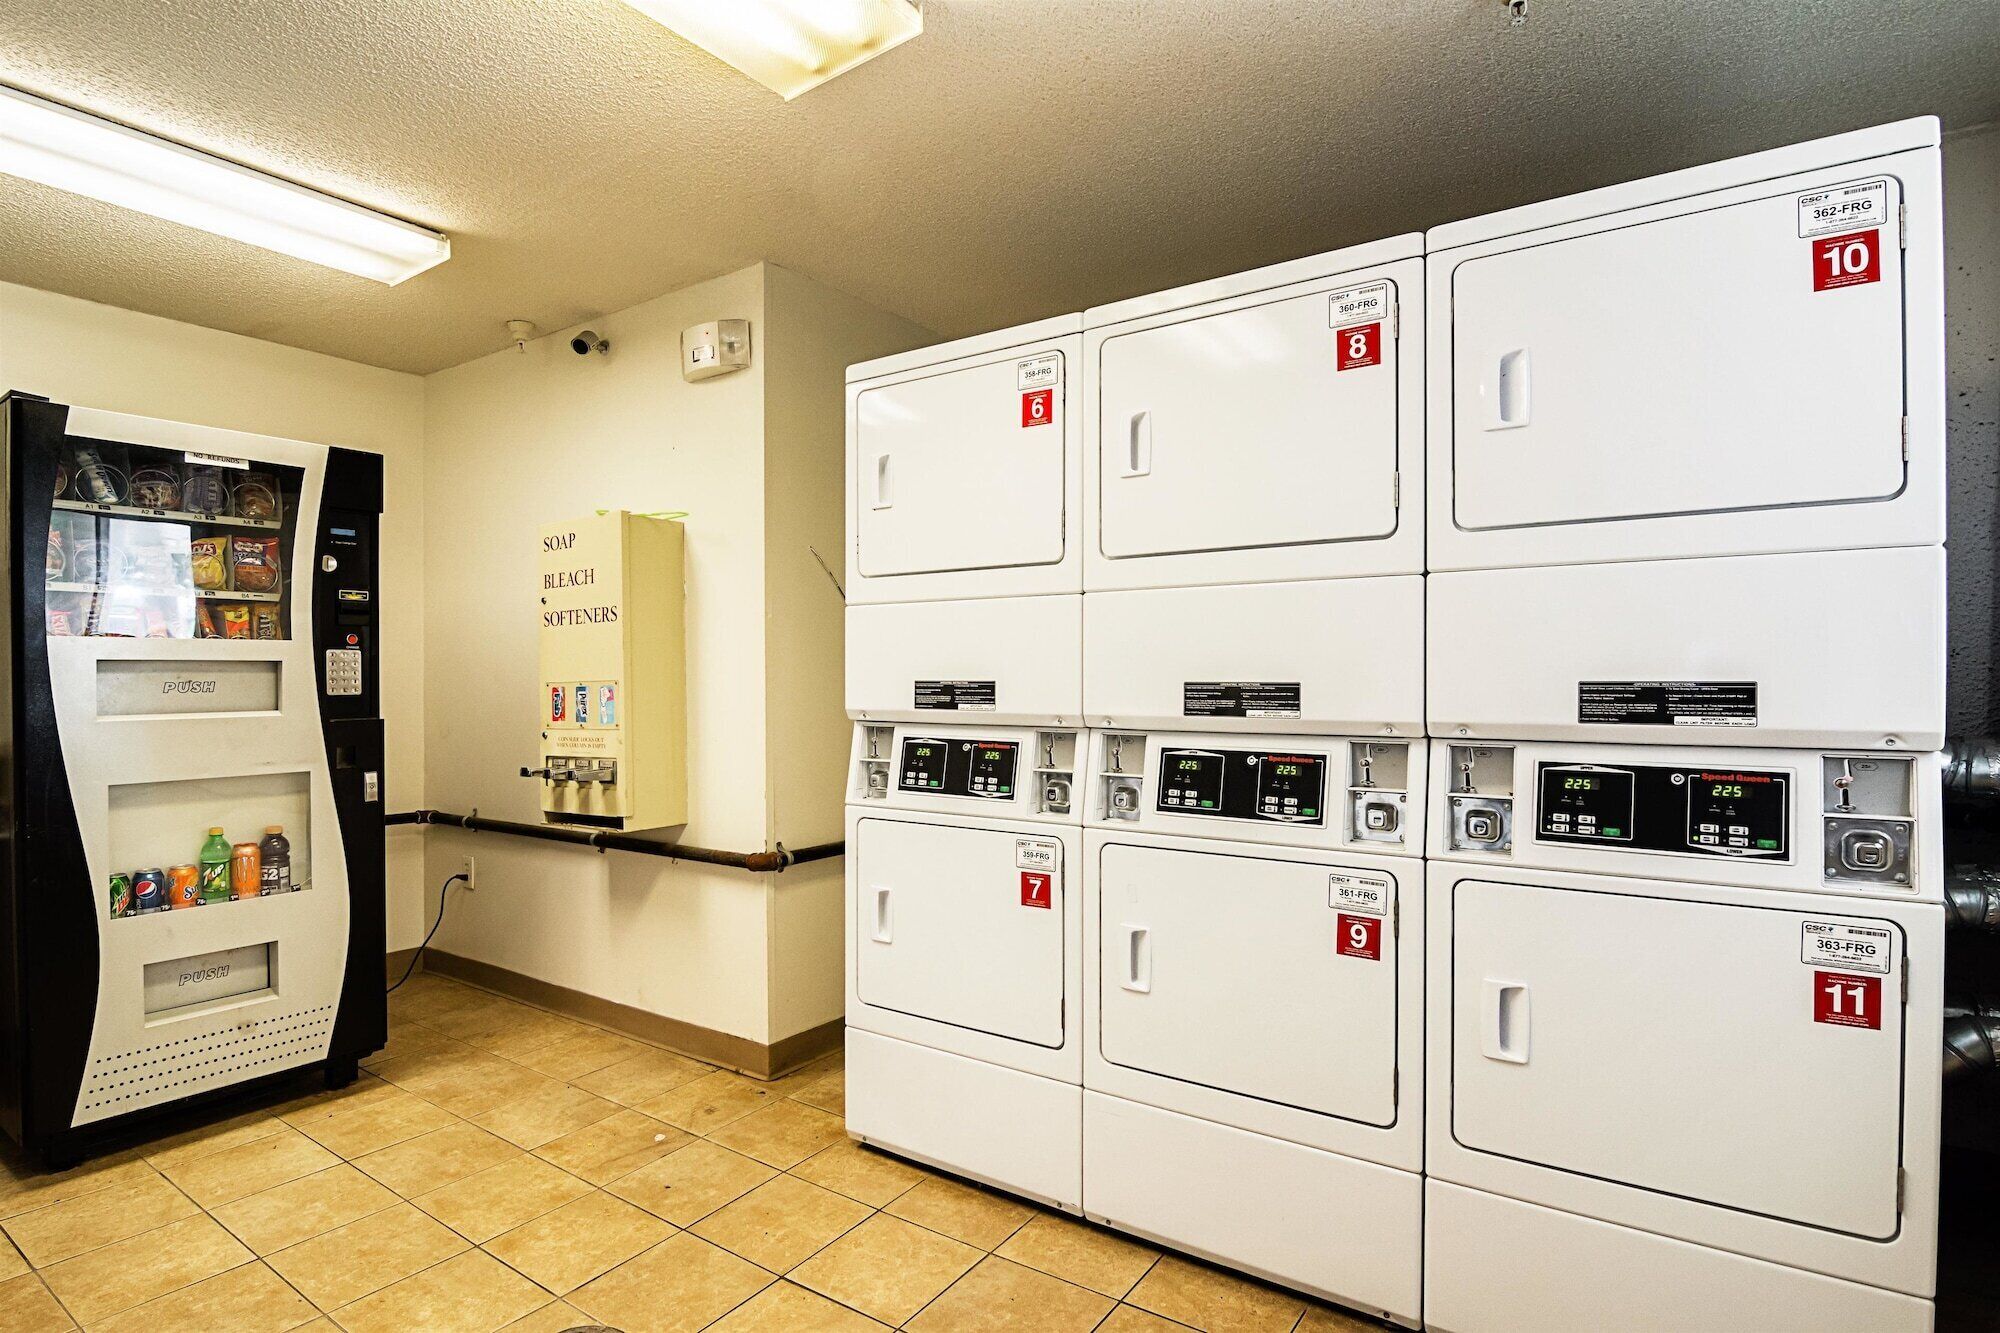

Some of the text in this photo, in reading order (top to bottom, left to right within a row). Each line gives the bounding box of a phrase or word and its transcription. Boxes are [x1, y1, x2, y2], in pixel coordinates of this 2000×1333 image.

[1801, 195, 1822, 204] CSC
[1813, 200, 1872, 219] 362-FRG
[1823, 242, 1869, 276] 10
[1339, 299, 1378, 313] 360-FRG
[1349, 334, 1367, 359] 8
[1024, 367, 1052, 379] 358-FRG
[1031, 398, 1044, 419] 6
[207, 454, 240, 464] REFUNDS
[543, 533, 576, 553] SOAP
[544, 568, 594, 589] BLEACH
[543, 605, 618, 627] SOFTENERS
[162, 680, 216, 693] PUSH
[578, 693, 588, 716] Purex
[916, 748, 931, 756] 225
[985, 751, 1000, 760] 225
[1179, 760, 1197, 770] 225
[1276, 765, 1297, 775] 225
[1564, 778, 1591, 790] 225
[1701, 773, 1771, 783] Speed Queen
[1712, 785, 1742, 797] 225
[1029, 879, 1042, 899] 7
[1338, 888, 1378, 901] 361-FRG
[1350, 923, 1368, 949] 9
[1816, 939, 1877, 955] 363-FRG
[178, 964, 230, 986] PUSH
[1824, 983, 1864, 1016] 11
